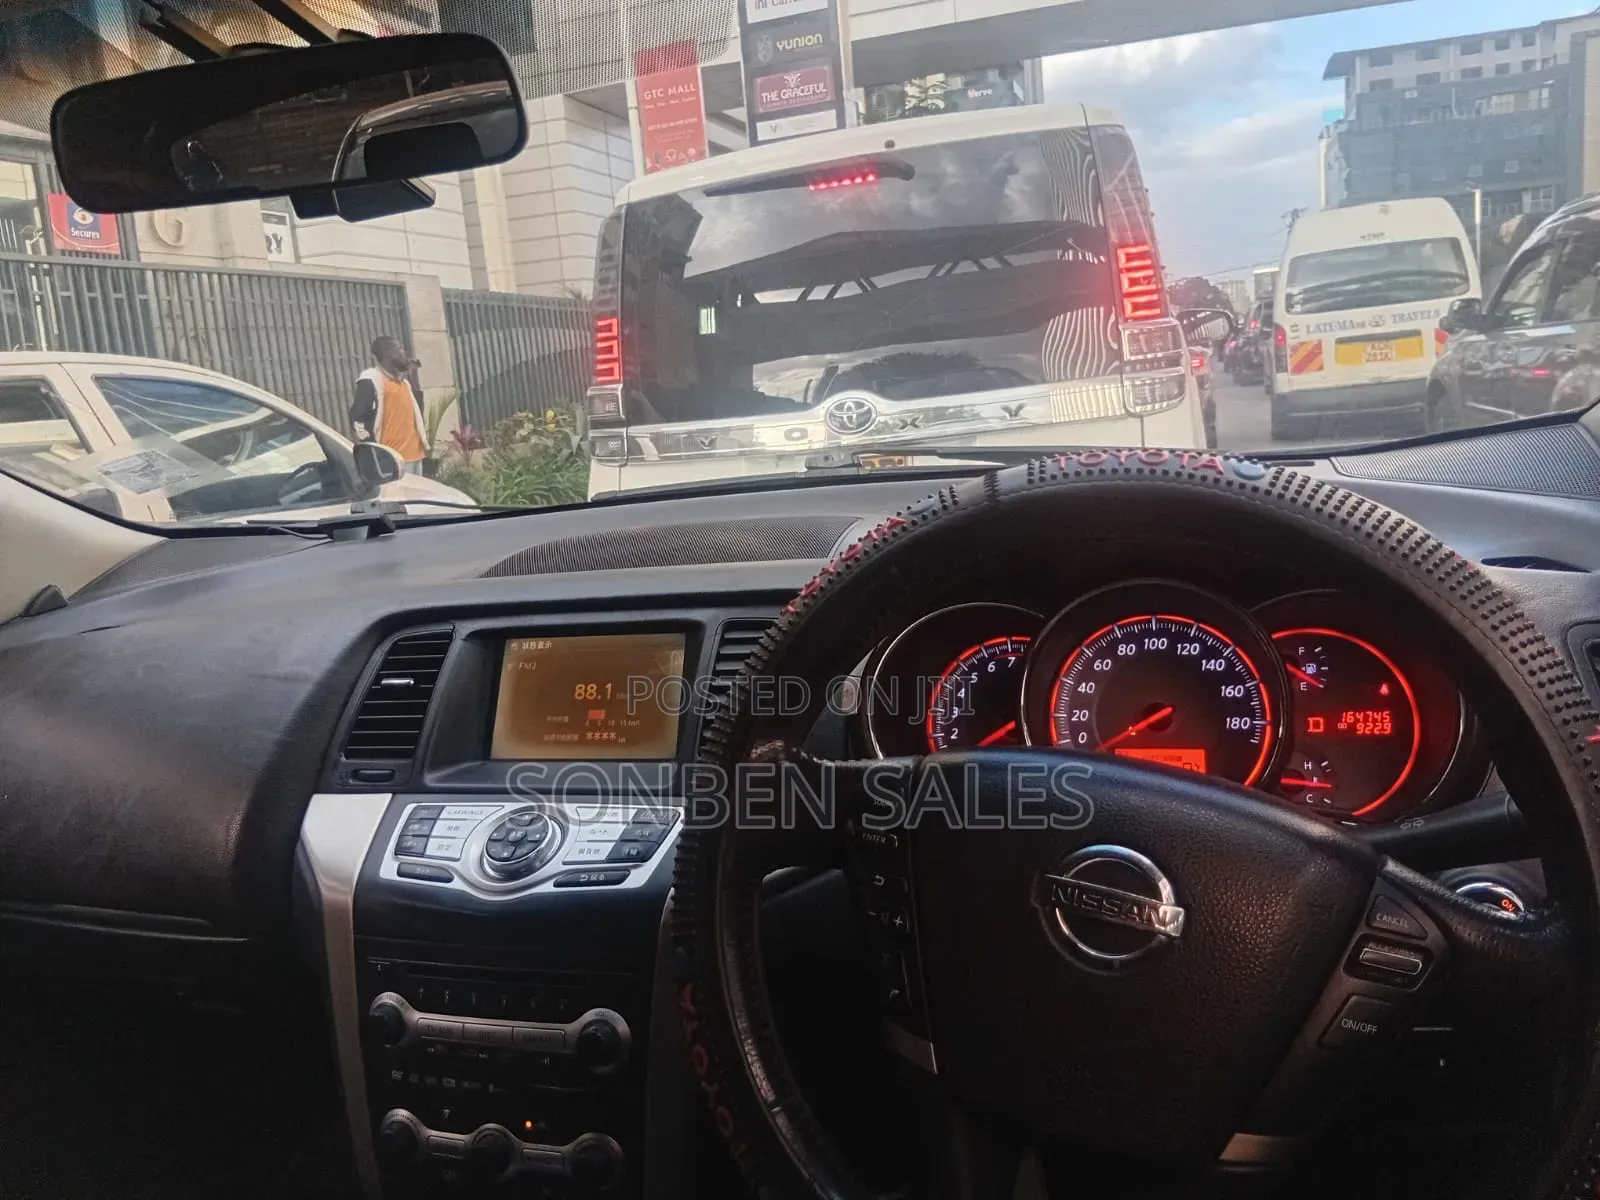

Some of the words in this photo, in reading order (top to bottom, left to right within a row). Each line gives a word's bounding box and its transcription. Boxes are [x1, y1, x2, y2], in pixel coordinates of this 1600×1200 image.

[644, 88, 664, 100] GTC
[668, 83, 696, 96] MALL
[761, 91, 780, 103] THE
[780, 82, 828, 99] GRACEFUL
[70, 227, 101, 239] Securex
[1390, 308, 1441, 324] TRAVELS
[1051, 449, 1225, 475] TOYOTA
[1117, 644, 1136, 655] 80
[1143, 638, 1168, 650] 100
[1177, 643, 1200, 655] 120
[1298, 647, 1305, 655] F
[987, 661, 996, 672] 6
[1007, 656, 1017, 668] 7
[1093, 659, 1112, 671] 60
[1201, 659, 1225, 671] 140
[970, 672, 979, 683] 5
[574, 682, 613, 700] 88.1
[1077, 682, 1095, 694] 40
[1221, 685, 1244, 697] 160
[1300, 682, 1307, 691] E
[957, 688, 965, 698] 4
[951, 706, 960, 718] 3
[1071, 709, 1089, 721] 20
[1341, 711, 1390, 723] 164745
[1226, 717, 1251, 729] 180
[1356, 722, 1392, 734] 922.9
[950, 727, 959, 739] 2
[1078, 732, 1087, 743] 0
[1304, 761, 1312, 770] H
[1305, 794, 1313, 803] C
[1051, 884, 1168, 931] NISSAN
[1501, 898, 1515, 912] ON
[1376, 913, 1409, 928] CANCEL
[1341, 1018, 1379, 1034] ON/OFF
